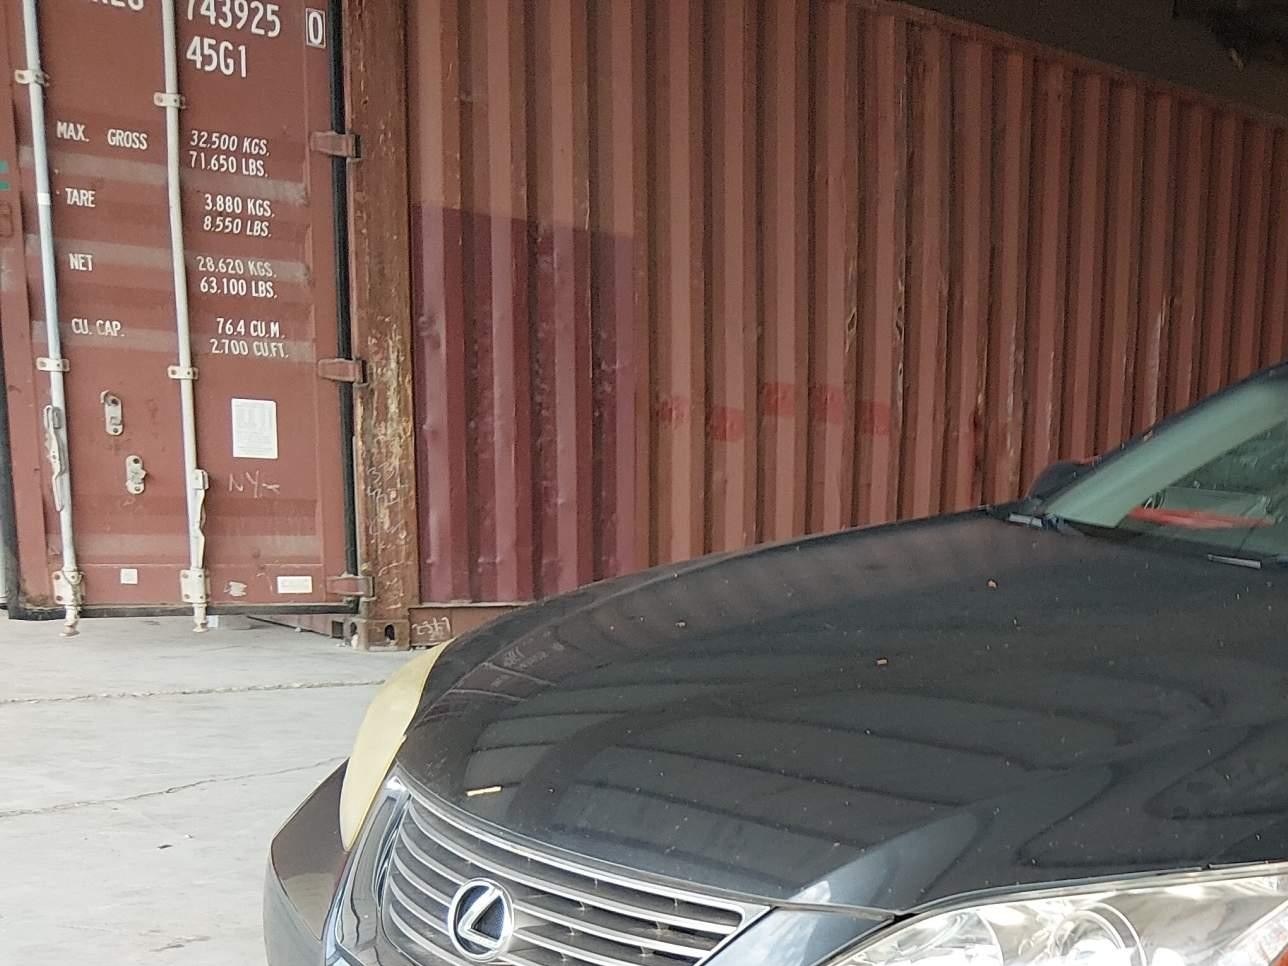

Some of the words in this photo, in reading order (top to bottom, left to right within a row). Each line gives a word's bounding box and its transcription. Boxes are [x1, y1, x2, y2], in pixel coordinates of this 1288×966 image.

[186, 35, 247, 78] 45G1
[56, 120, 90, 143] MAX.
[107, 128, 148, 151] GROSS
[65, 187, 96, 208] TARE
[69, 253, 93, 272] NET
[72, 318, 93, 335] CU.
[96, 319, 125, 337] CAP.
[216, 318, 246, 336] 76.4
